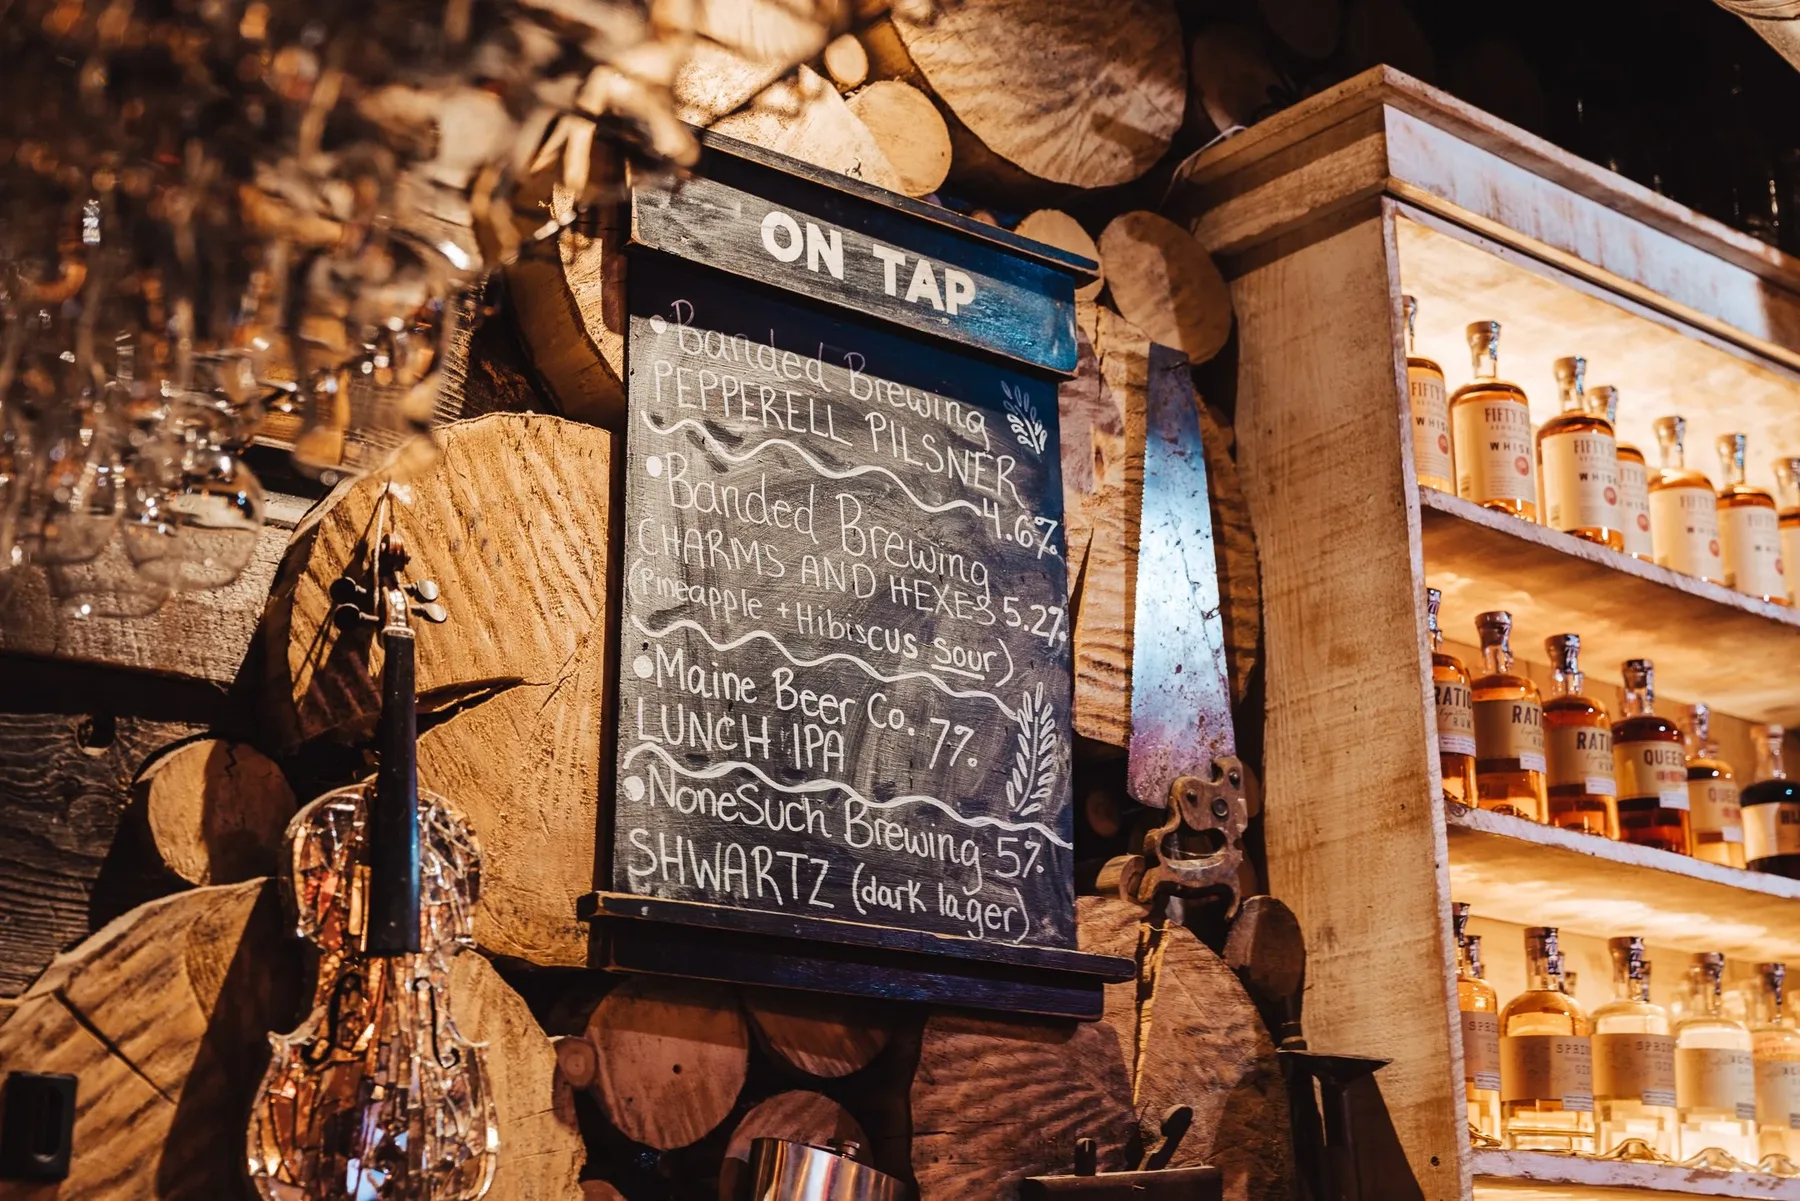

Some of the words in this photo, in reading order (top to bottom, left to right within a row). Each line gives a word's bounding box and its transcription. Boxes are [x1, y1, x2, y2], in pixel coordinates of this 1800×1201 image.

[761, 211, 844, 280] ON
[873, 244, 976, 316] TAP
[671, 299, 827, 393] Banded
[844, 352, 991, 451] Brewing
[1484, 407, 1517, 424] FIFTY
[654, 360, 852, 446] PEPPERELL
[865, 412, 1025, 509] PILSNER
[662, 452, 819, 545] Banded
[835, 494, 990, 598] Brewing
[980, 497, 1058, 559] 4.6%
[638, 517, 786, 578] CHARMS
[801, 555, 876, 599] AND
[890, 575, 996, 626] HEXES
[1003, 596, 1067, 648] 5.2%
[637, 696, 770, 760] LUNCH
[793, 723, 845, 773] IPA
[656, 644, 757, 704] Maine
[772, 667, 856, 726] Beer
[867, 694, 915, 737] Co.
[628, 828, 834, 909] SHWARTZ
[852, 862, 927, 915] (dark
[938, 887, 1030, 944] lager)
[844, 798, 982, 896] Brewing
[994, 836, 1044, 879] 5%
